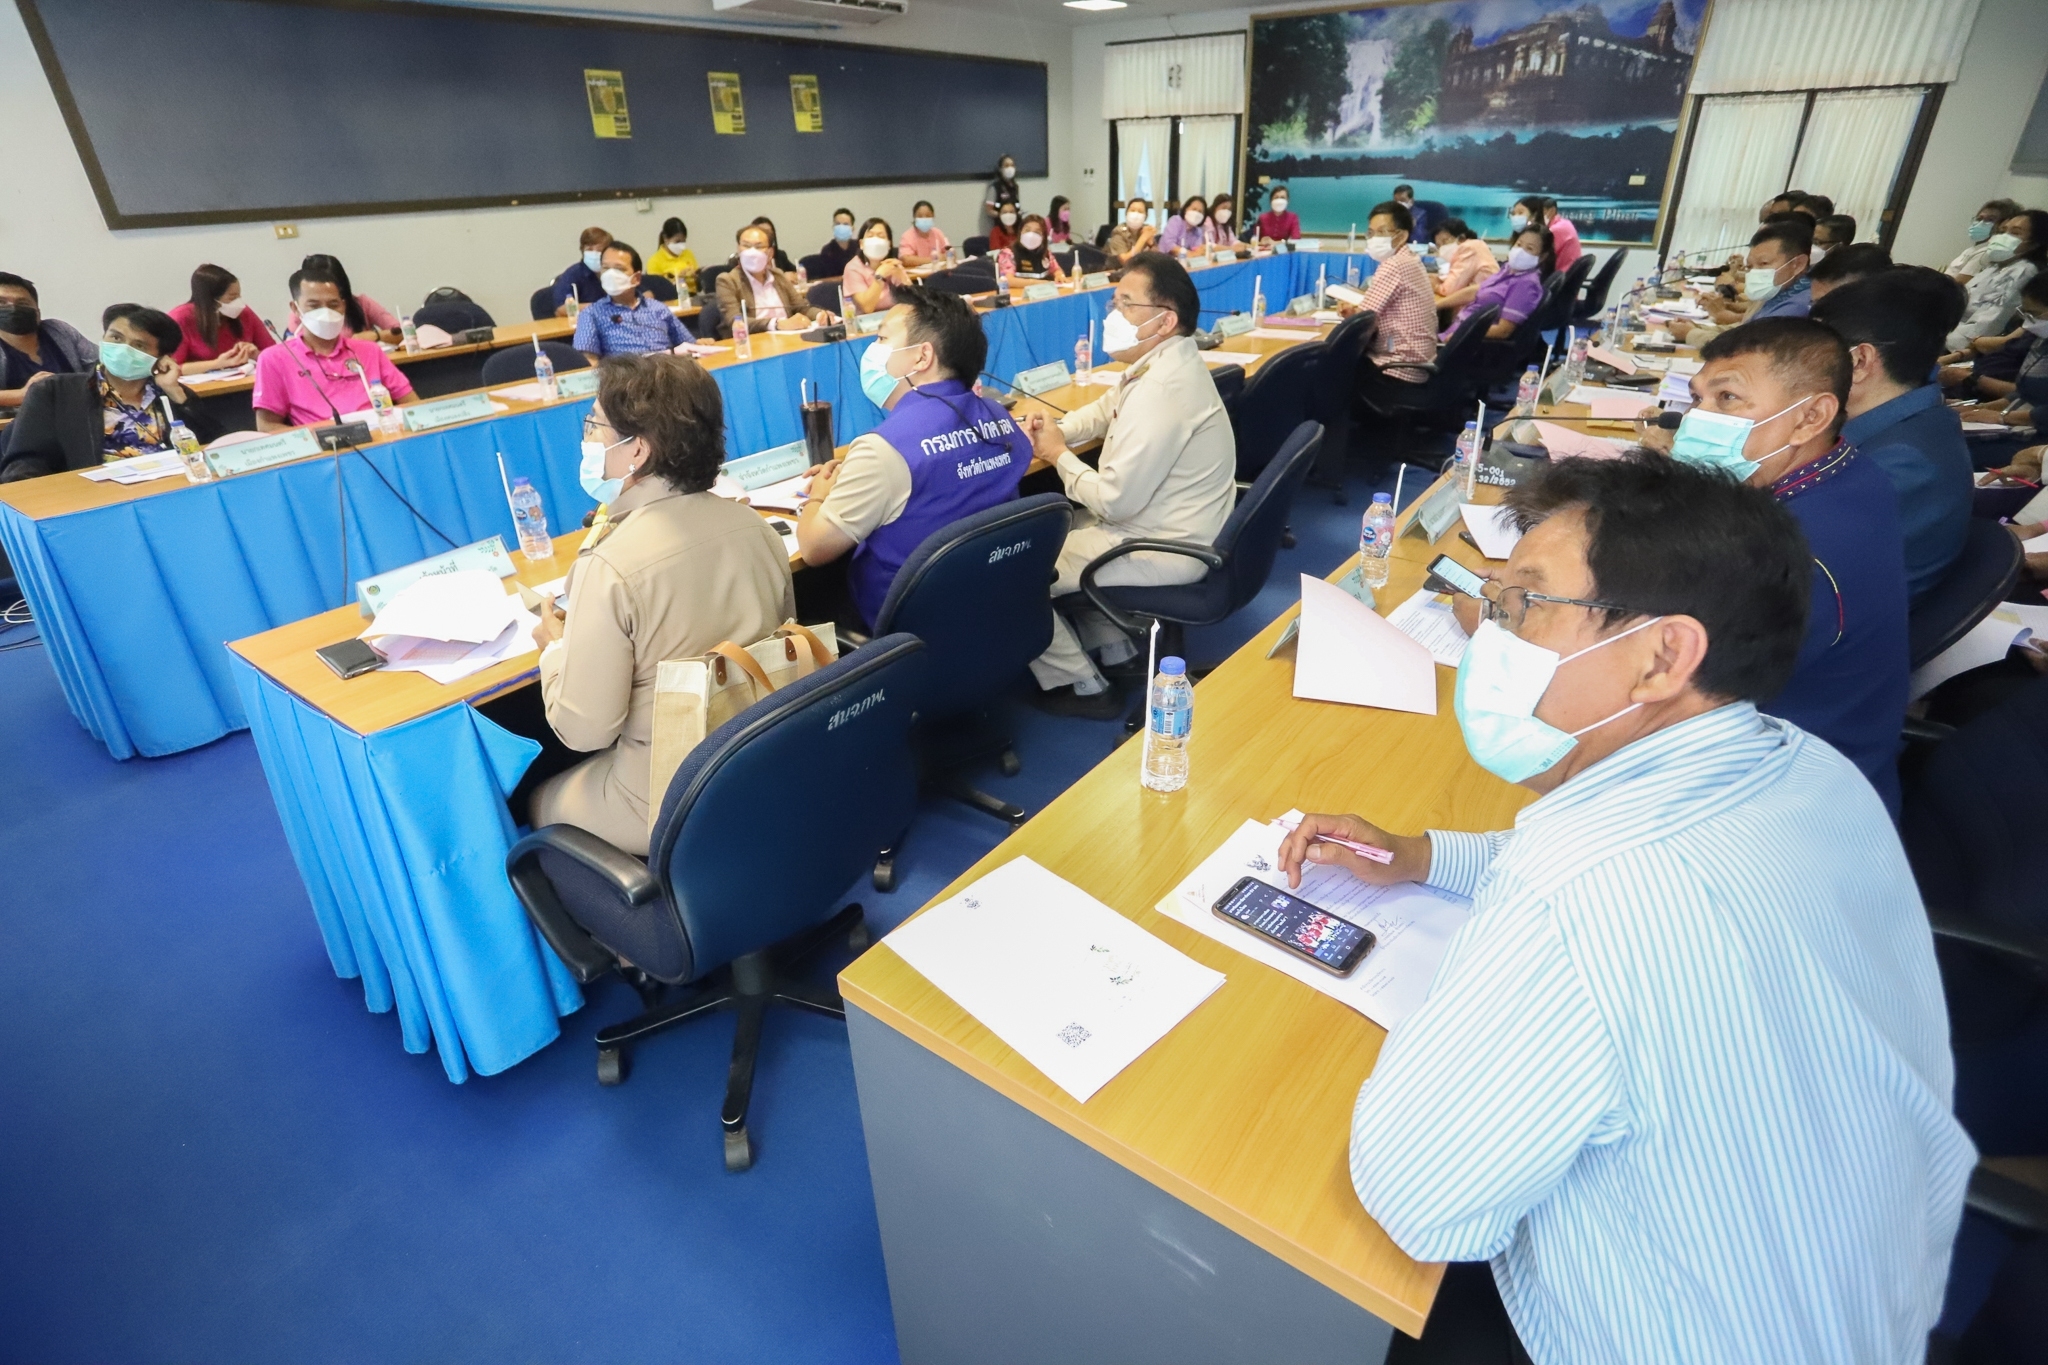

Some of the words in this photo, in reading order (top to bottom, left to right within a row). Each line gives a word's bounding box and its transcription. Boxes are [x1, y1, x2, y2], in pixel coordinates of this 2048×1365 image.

[956, 452, 1012, 480] จังหวัดกำแพงเพชร
